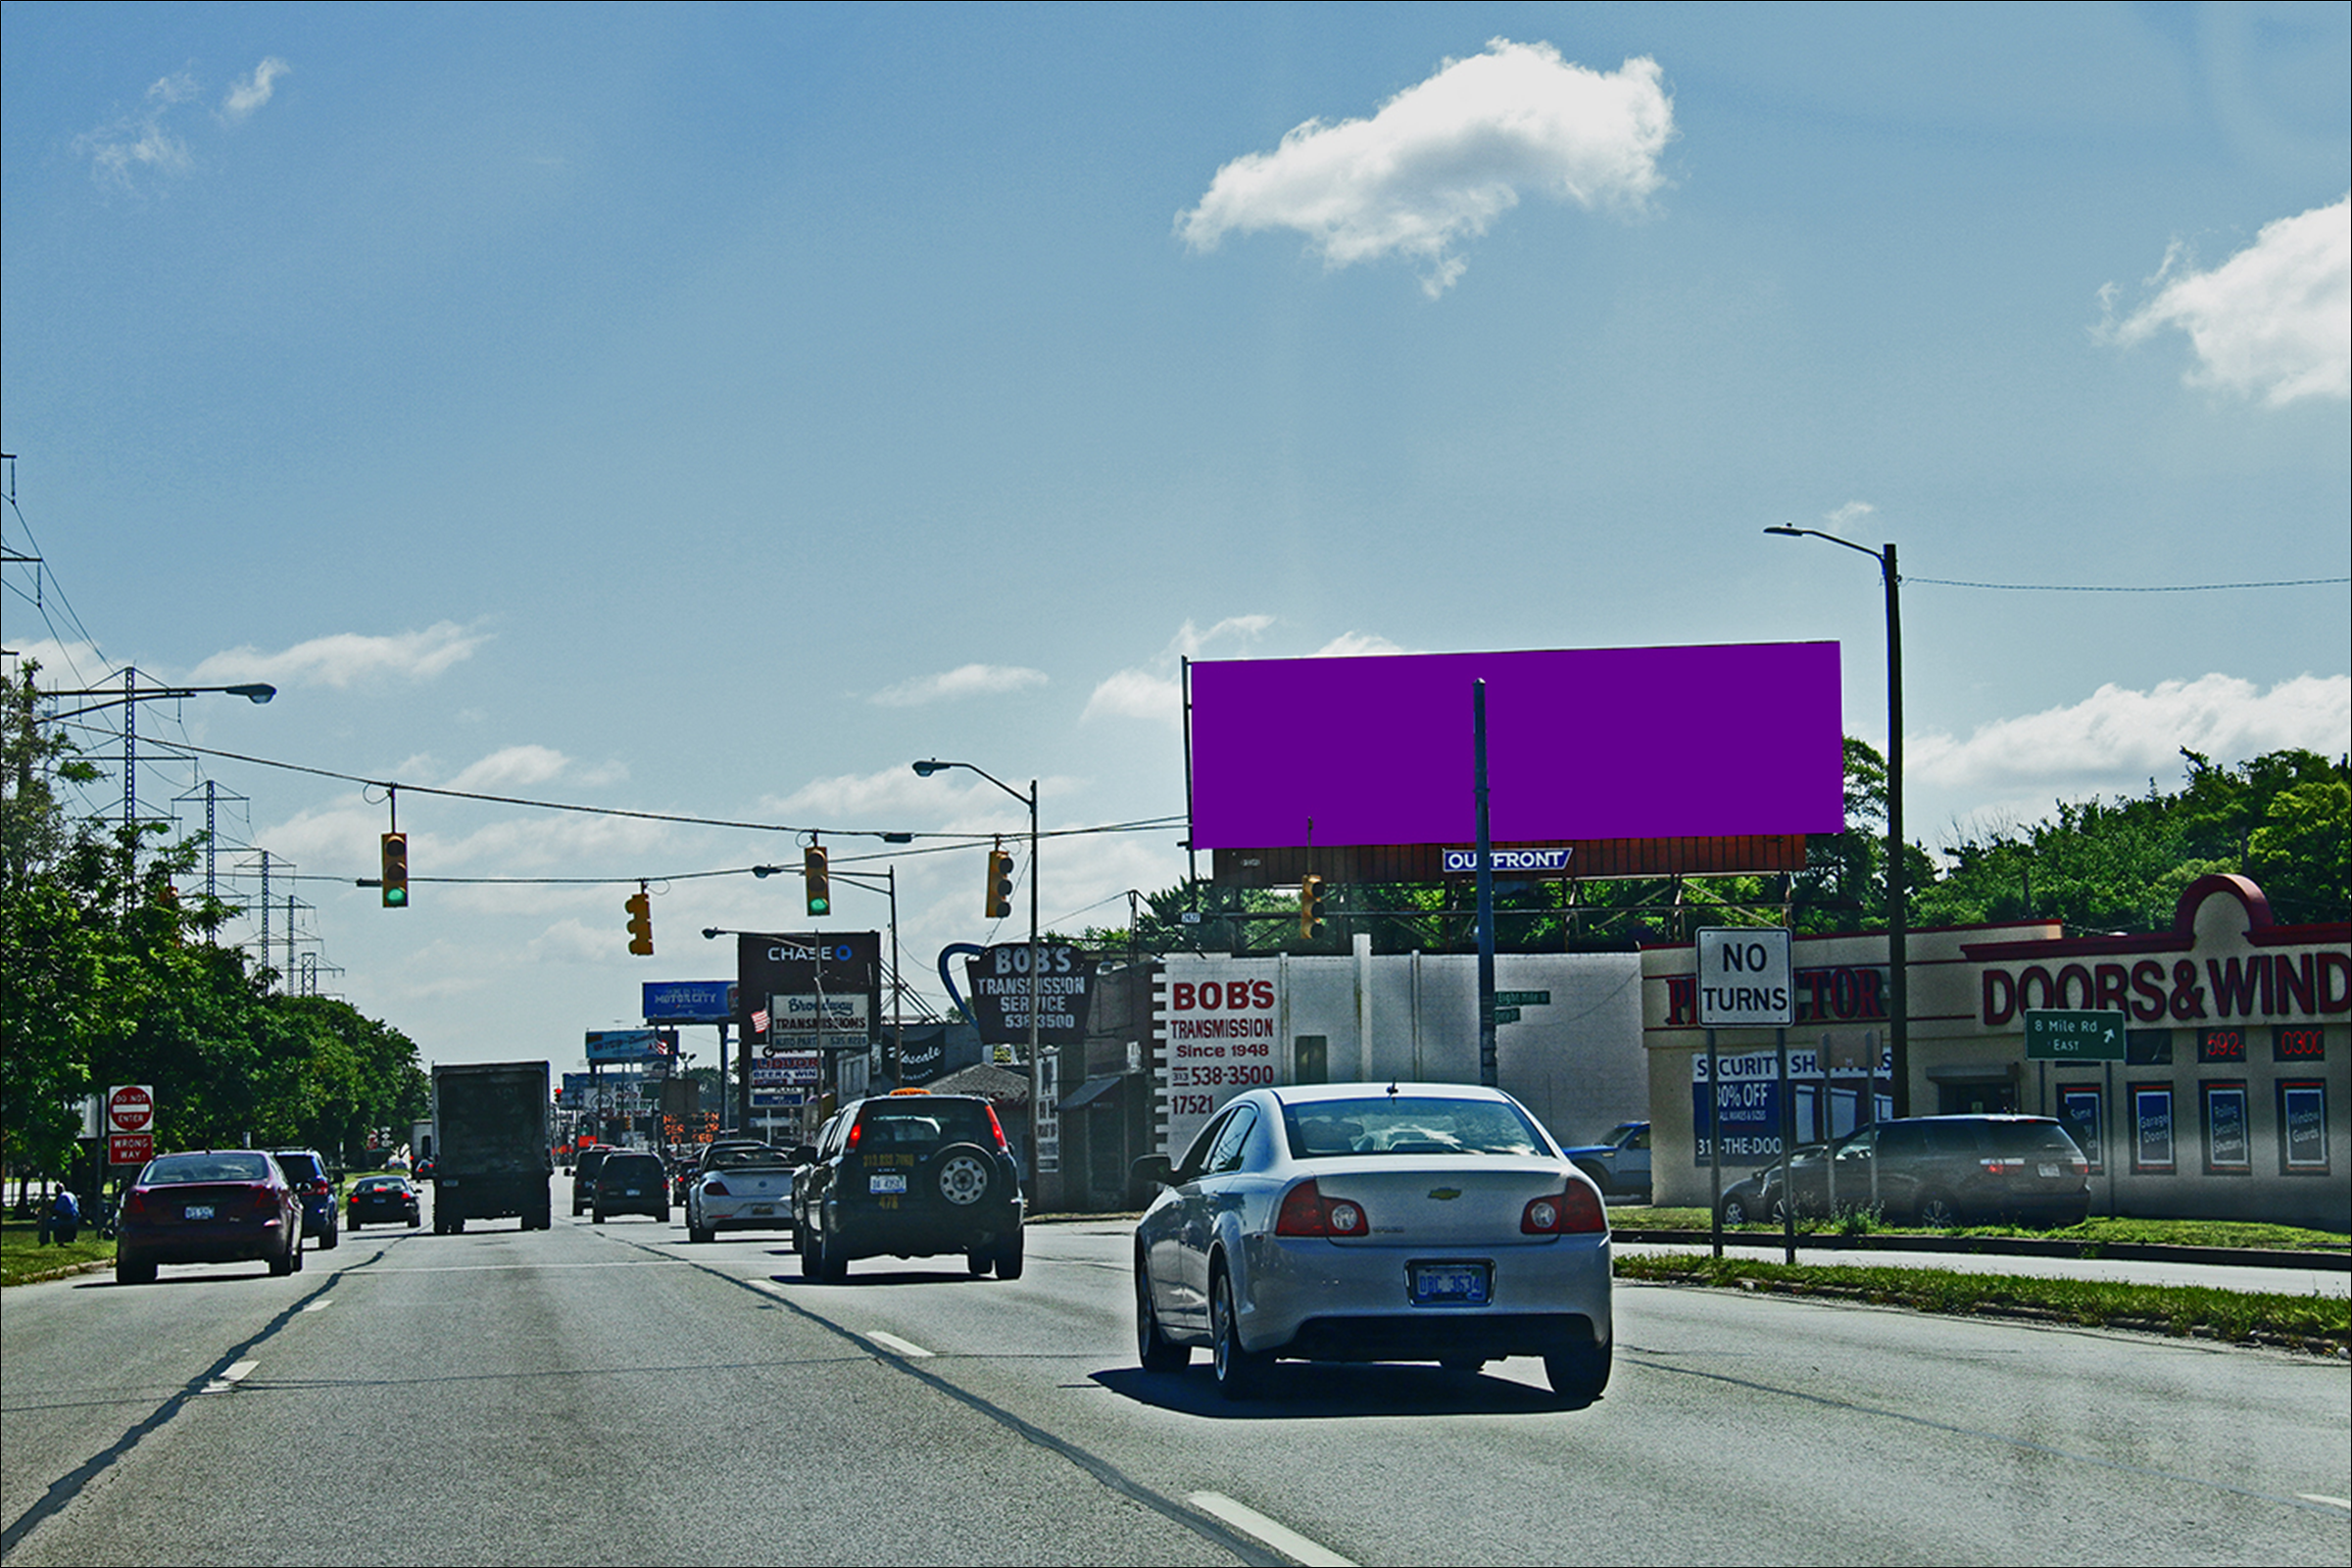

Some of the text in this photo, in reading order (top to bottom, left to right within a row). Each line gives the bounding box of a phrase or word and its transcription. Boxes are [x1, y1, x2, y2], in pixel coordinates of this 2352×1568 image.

[1448, 852, 1564, 868] OUFRONT
[767, 947, 832, 960] CHASE
[996, 947, 1072, 974] BOB'S
[1723, 944, 1767, 972] NO
[1173, 978, 1275, 1010] BOB'S
[1702, 988, 1788, 1011] TURNS
[788, 998, 855, 1016] Brodway
[1171, 1018, 1273, 1039] TRANSMISSION
[2034, 1020, 2097, 1032] 8 Mile Rd
[797, 1036, 818, 1046] PART
[2053, 1039, 2080, 1052] EAST
[1177, 1044, 1269, 1058] Since 1948
[757, 1058, 818, 1069] LIQUOR
[1697, 1057, 1780, 1077] SCURIT
[794, 1069, 816, 1078] WIN
[1173, 1065, 1274, 1085] 313 538-3500
[116, 1093, 147, 1102] DO NOT
[1743, 1083, 1768, 1106] OFF
[1171, 1095, 1214, 1114] 17521
[118, 1114, 144, 1123] ENTER
[114, 1139, 149, 1149] WRONG
[1697, 1137, 1783, 1155] 31-THE-DOO
[121, 1151, 141, 1159] WAY
